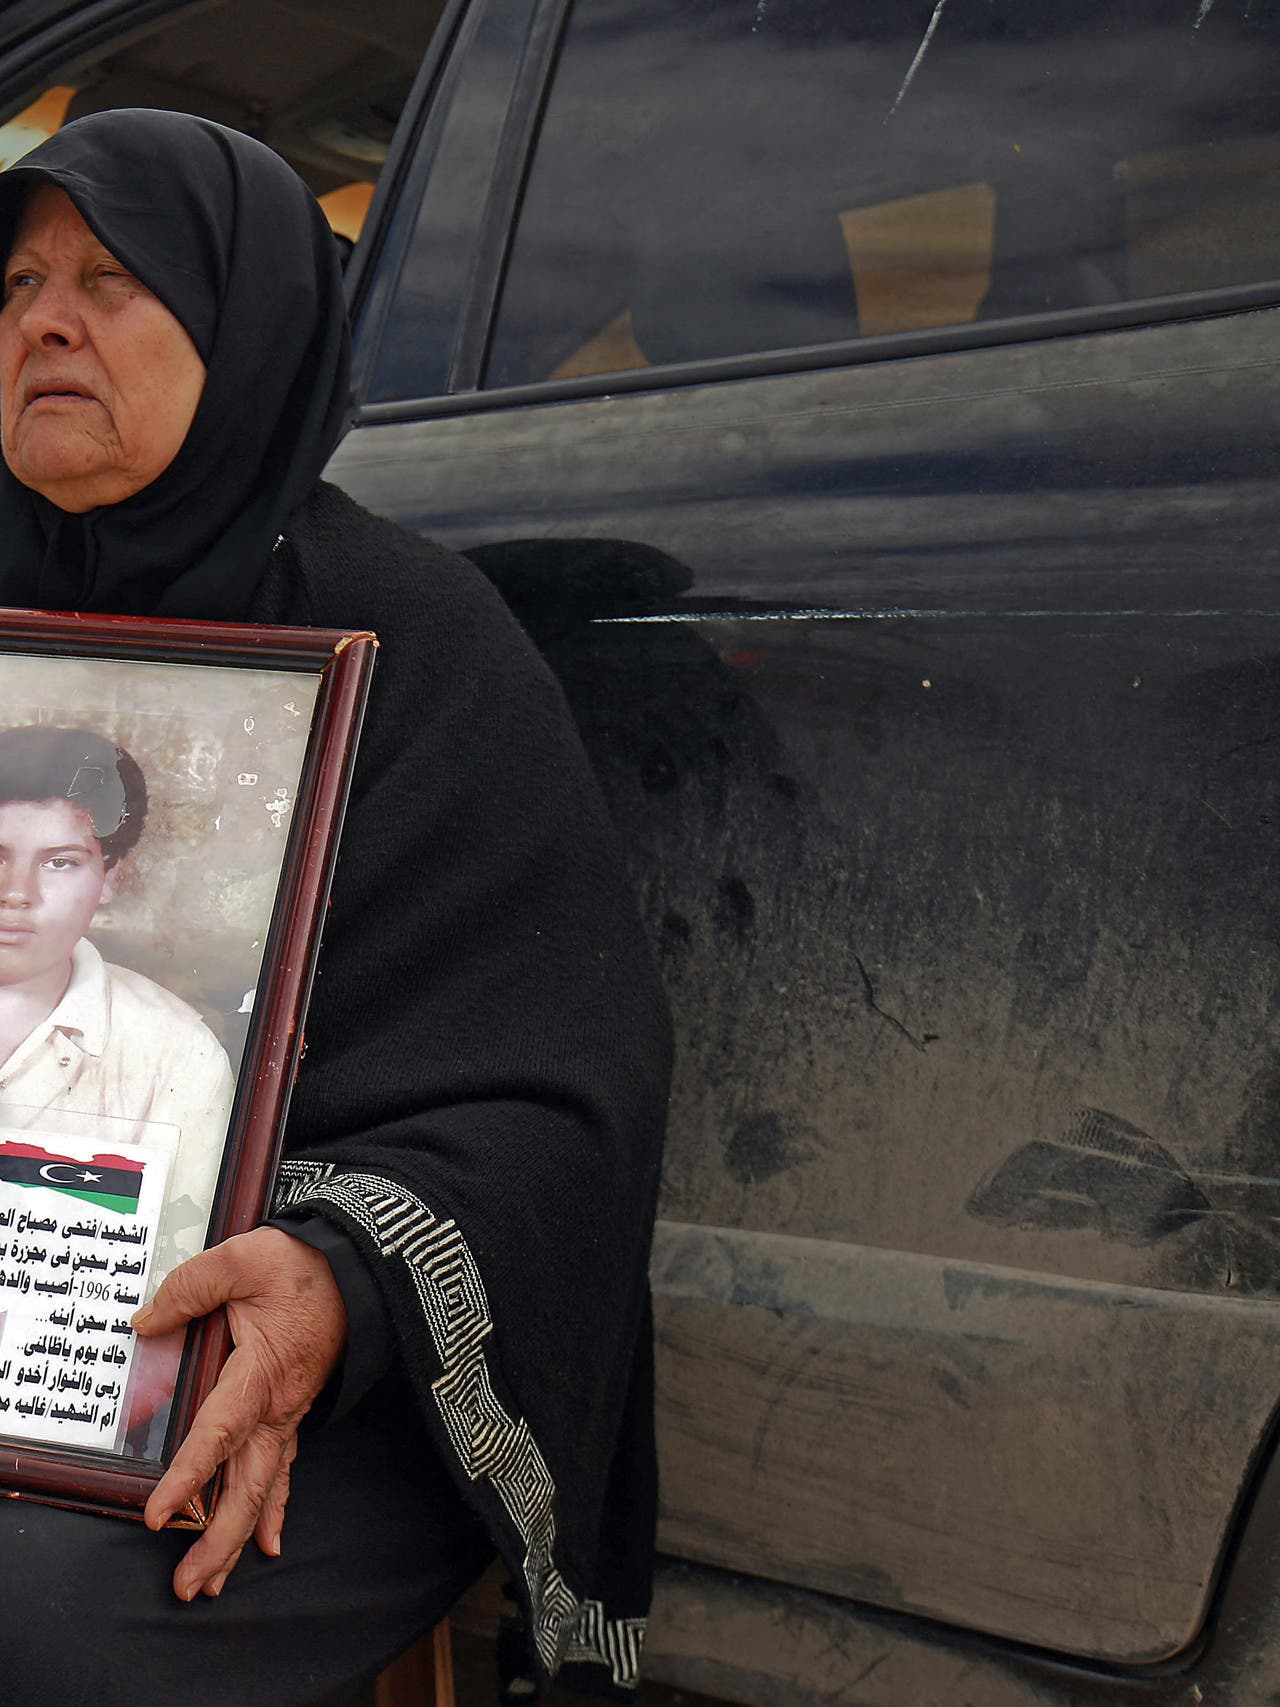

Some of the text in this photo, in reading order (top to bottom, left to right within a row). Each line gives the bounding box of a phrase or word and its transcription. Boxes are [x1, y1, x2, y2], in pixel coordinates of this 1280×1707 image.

[17, 1210, 57, 1234] مصباح
[11, 1239, 47, 1264] مجزرة
[72, 1252, 109, 1273] سجين
[109, 1251, 147, 1277] أصغر
[114, 1283, 140, 1305] سنة
[76, 1314, 107, 1334] سجن
[110, 1317, 133, 1339] بعد
[73, 1345, 99, 1366] يوم
[102, 1344, 127, 1368] جاك
[14, 1360, 49, 1386] أخدو
[47, 1368, 92, 1396] والثوار
[100, 1401, 117, 1432] أم
